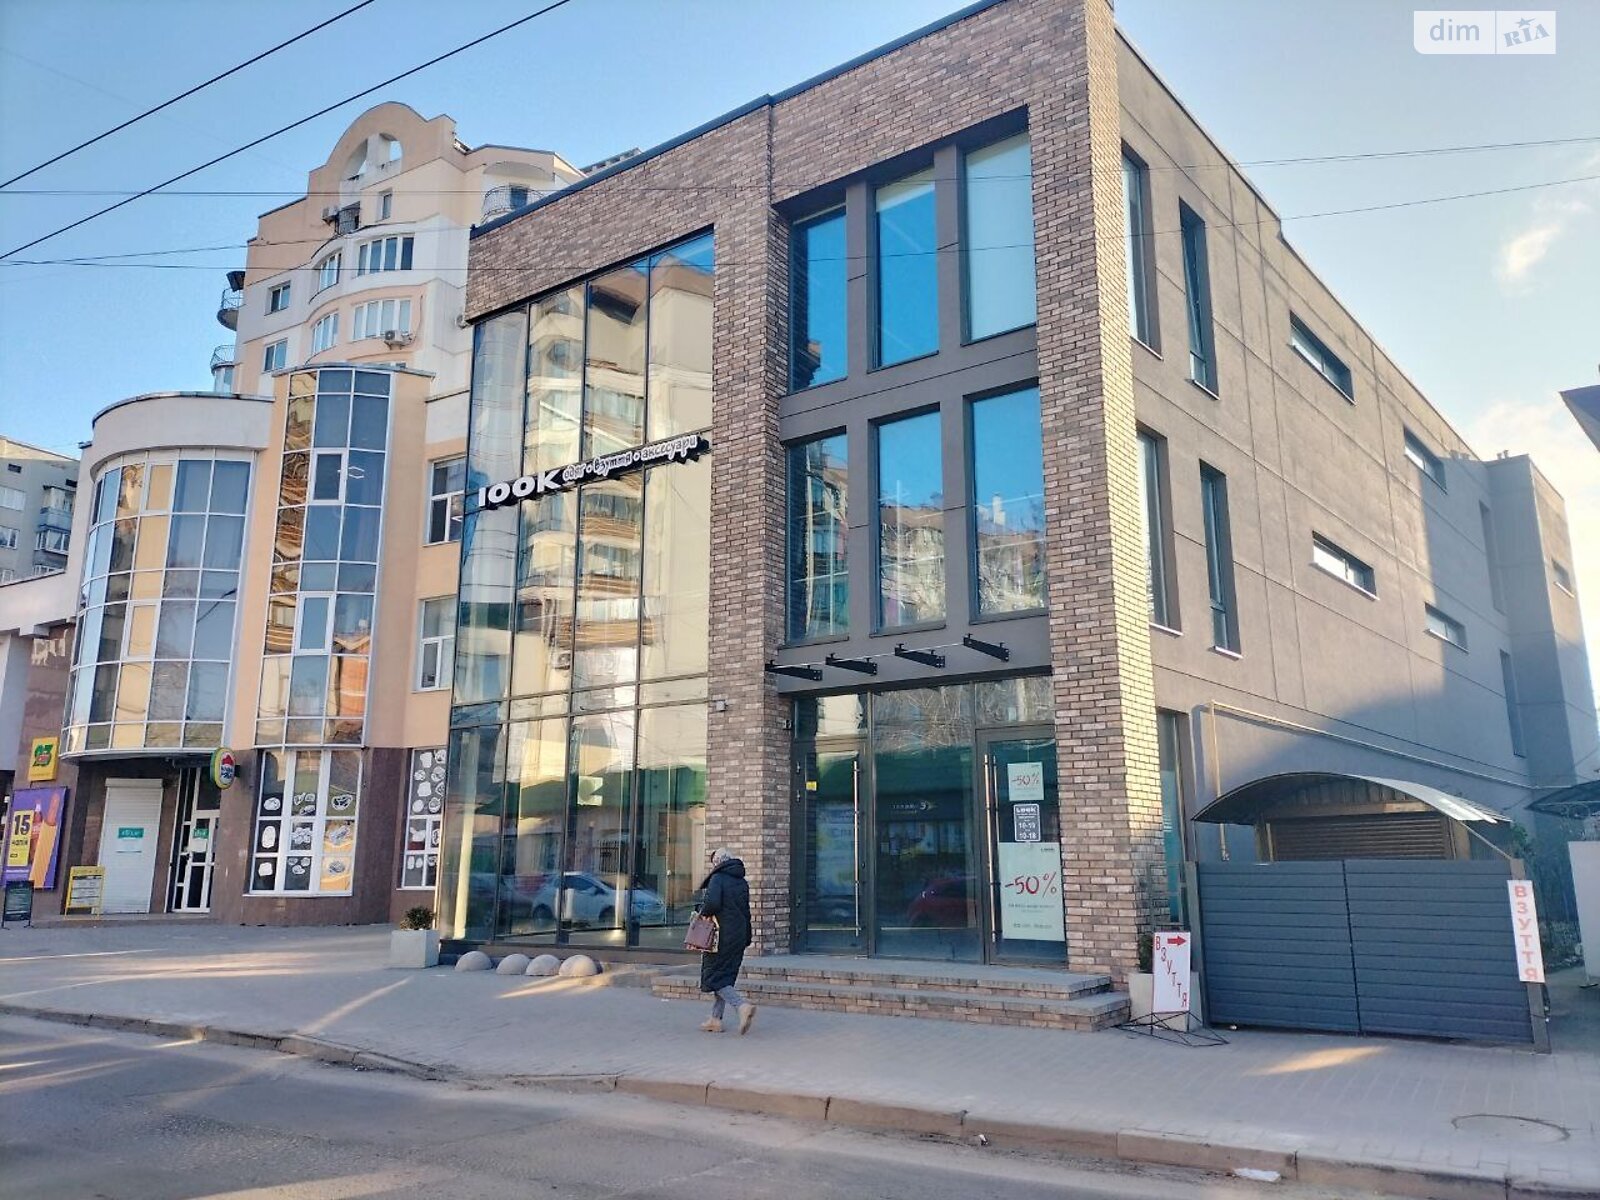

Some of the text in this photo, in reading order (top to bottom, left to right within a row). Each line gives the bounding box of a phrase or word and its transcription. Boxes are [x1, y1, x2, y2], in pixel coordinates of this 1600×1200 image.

[641, 434, 699, 462] аксесуари
[14, 814, 31, 836] 15
[1004, 871, 1058, 898] -50%
[1513, 885, 1538, 980] ВЗУТТЯ
[1155, 935, 1188, 1008] ВЗУТТЯ
